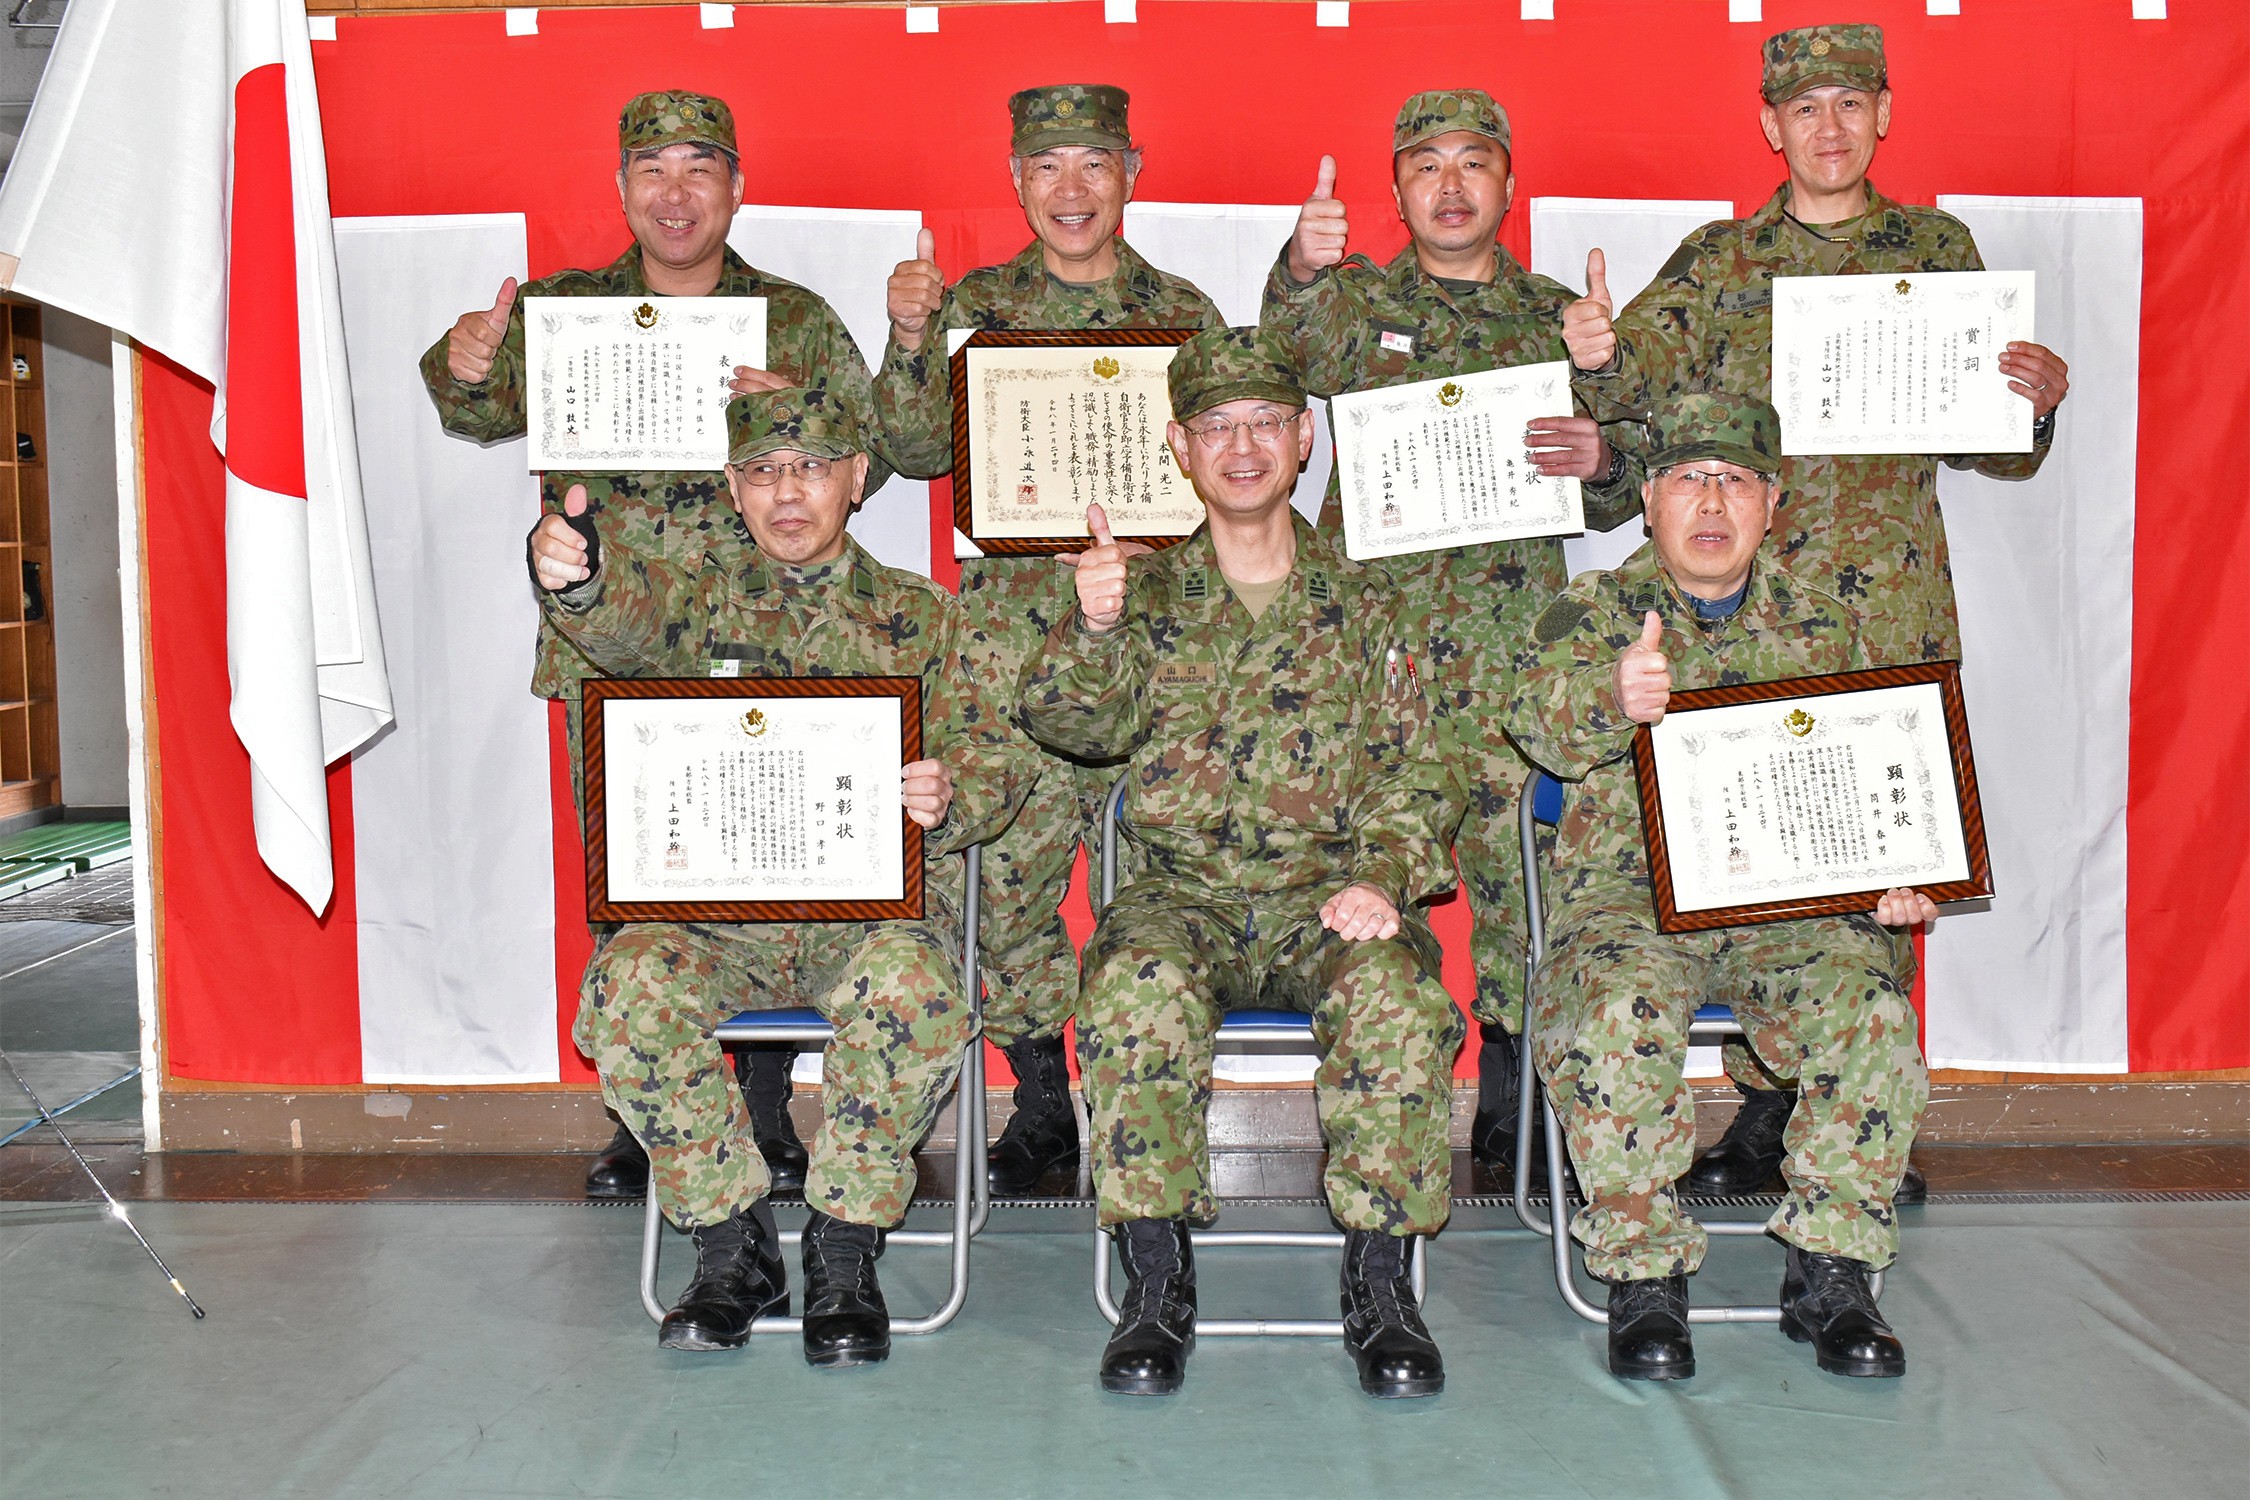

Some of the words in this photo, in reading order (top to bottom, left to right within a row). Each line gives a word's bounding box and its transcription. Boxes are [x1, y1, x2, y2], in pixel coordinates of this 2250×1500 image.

[1731, 298, 1772, 310] S.SUGIMOT
[1964, 328, 1980, 371] 賞詞
[1048, 400, 1060, 472] 令和八年一月二十四日
[1118, 392, 1136, 503] 自衛官及び即応予備自衛官
[1137, 393, 1153, 503] あなたは永年にわたり予備
[1159, 442, 1172, 495] 本間光二
[1507, 459, 1519, 507] 亀井秀紀
[1157, 675, 1208, 683] A.YAMAGUCHI
[1167, 665, 1196, 675] 山口
[836, 775, 854, 838] 顕彰状
[1887, 764, 1912, 827] 顕彰状
[815, 802, 826, 865] 野口孝臣
